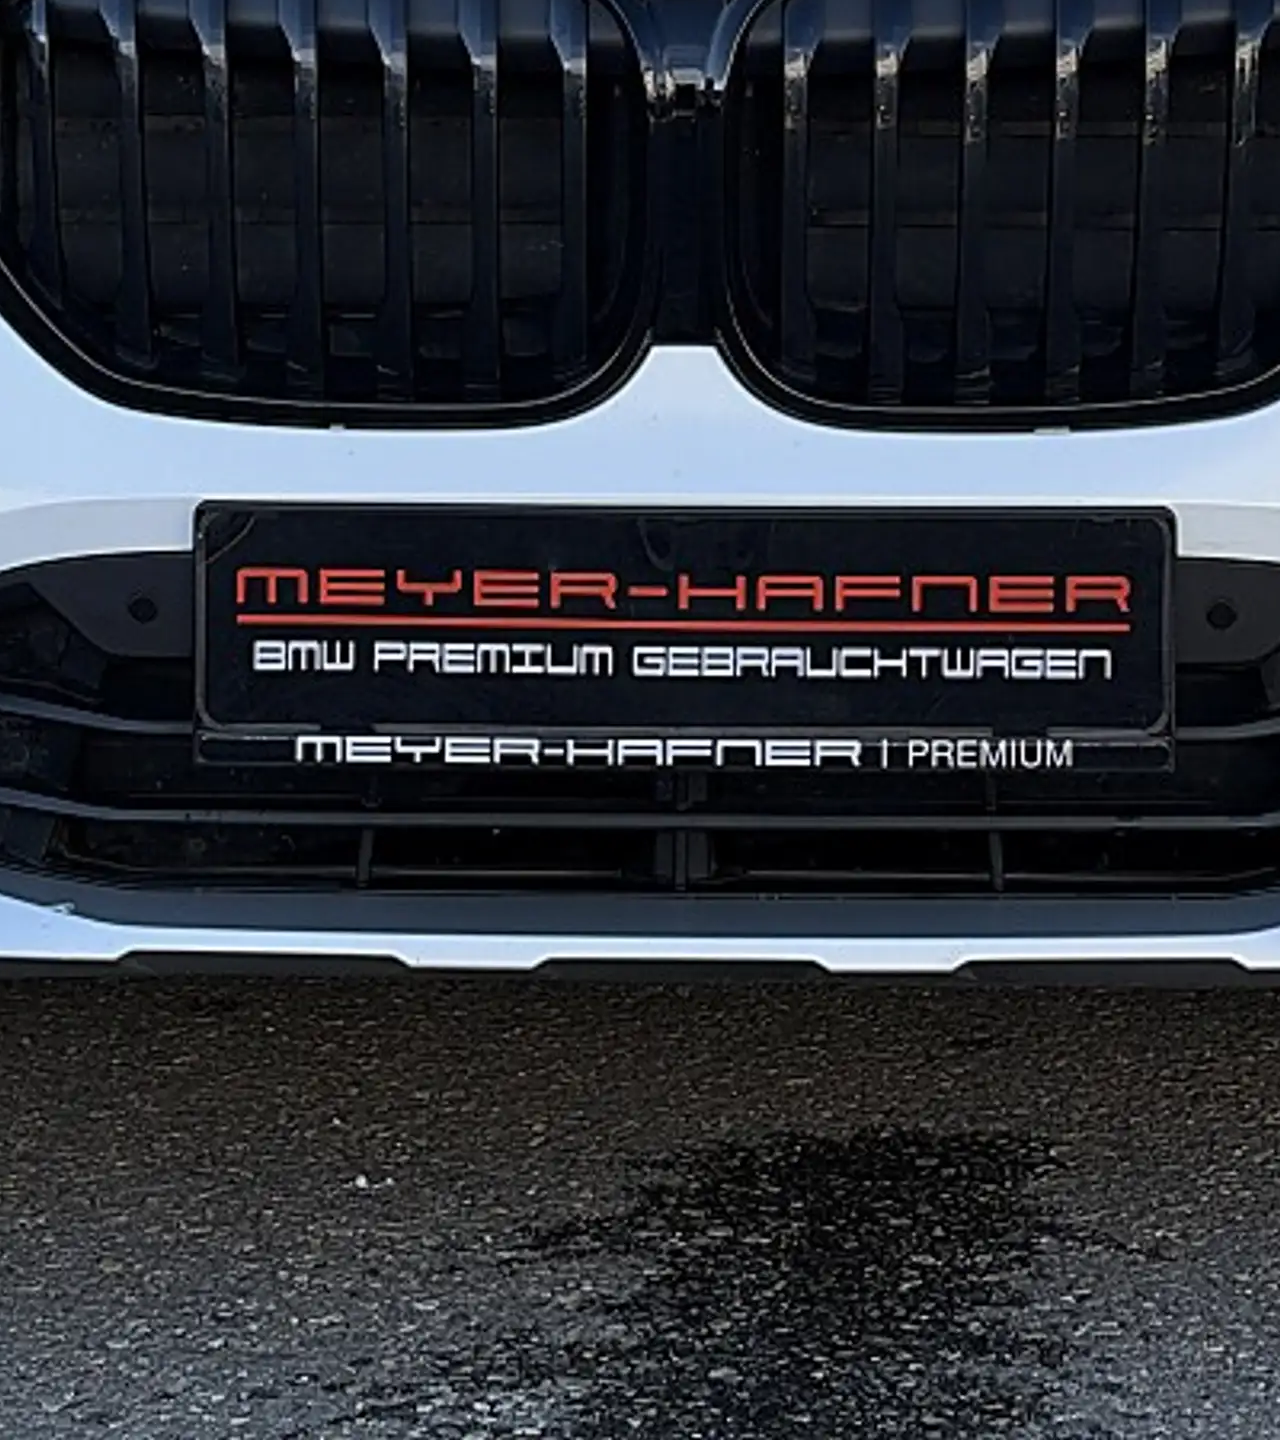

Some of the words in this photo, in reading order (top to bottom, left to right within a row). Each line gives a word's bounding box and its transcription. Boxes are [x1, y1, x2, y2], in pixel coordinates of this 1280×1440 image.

[236, 567, 1130, 612] MEYER-HAFNER
[253, 640, 356, 673] BMW
[373, 642, 614, 678] PREMIUM
[632, 645, 1113, 680] GEBRAUCHTWAGEN
[295, 735, 863, 768] MEYER-HAFNER
[907, 739, 1074, 769] PREMIUM
